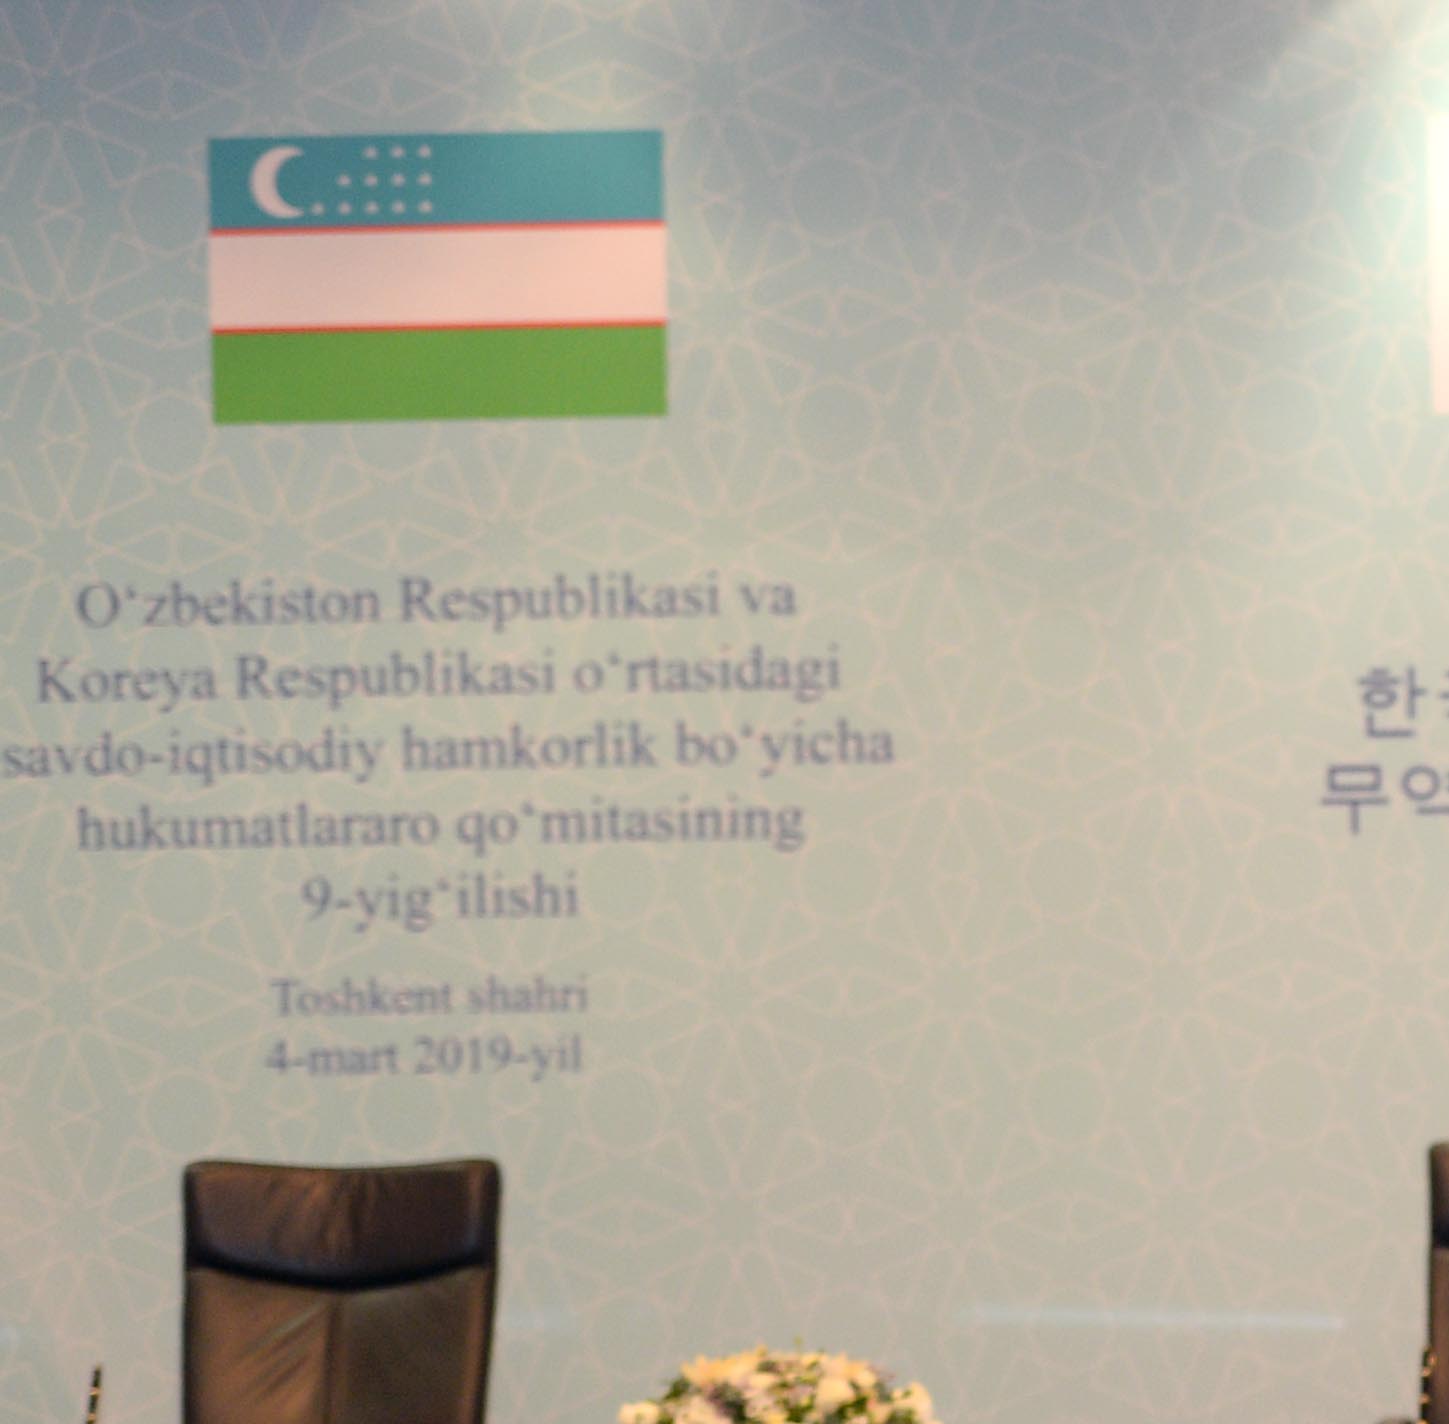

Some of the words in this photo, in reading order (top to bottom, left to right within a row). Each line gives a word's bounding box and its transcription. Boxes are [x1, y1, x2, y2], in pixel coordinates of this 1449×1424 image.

[400, 573, 721, 633] Respublikasi
[741, 583, 798, 617] va
[36, 656, 217, 714] Koreya
[236, 651, 556, 709] Respublikasi
[1, 728, 384, 785] savdo-iqtisodiy
[402, 721, 657, 772] hamkorlik
[77, 803, 441, 852] hukumatlararo
[271, 976, 453, 1016] Toshkent
[468, 973, 589, 1014] shahri
[265, 1039, 399, 1076] 4-mart
[413, 1033, 583, 1083] 2019-yil
